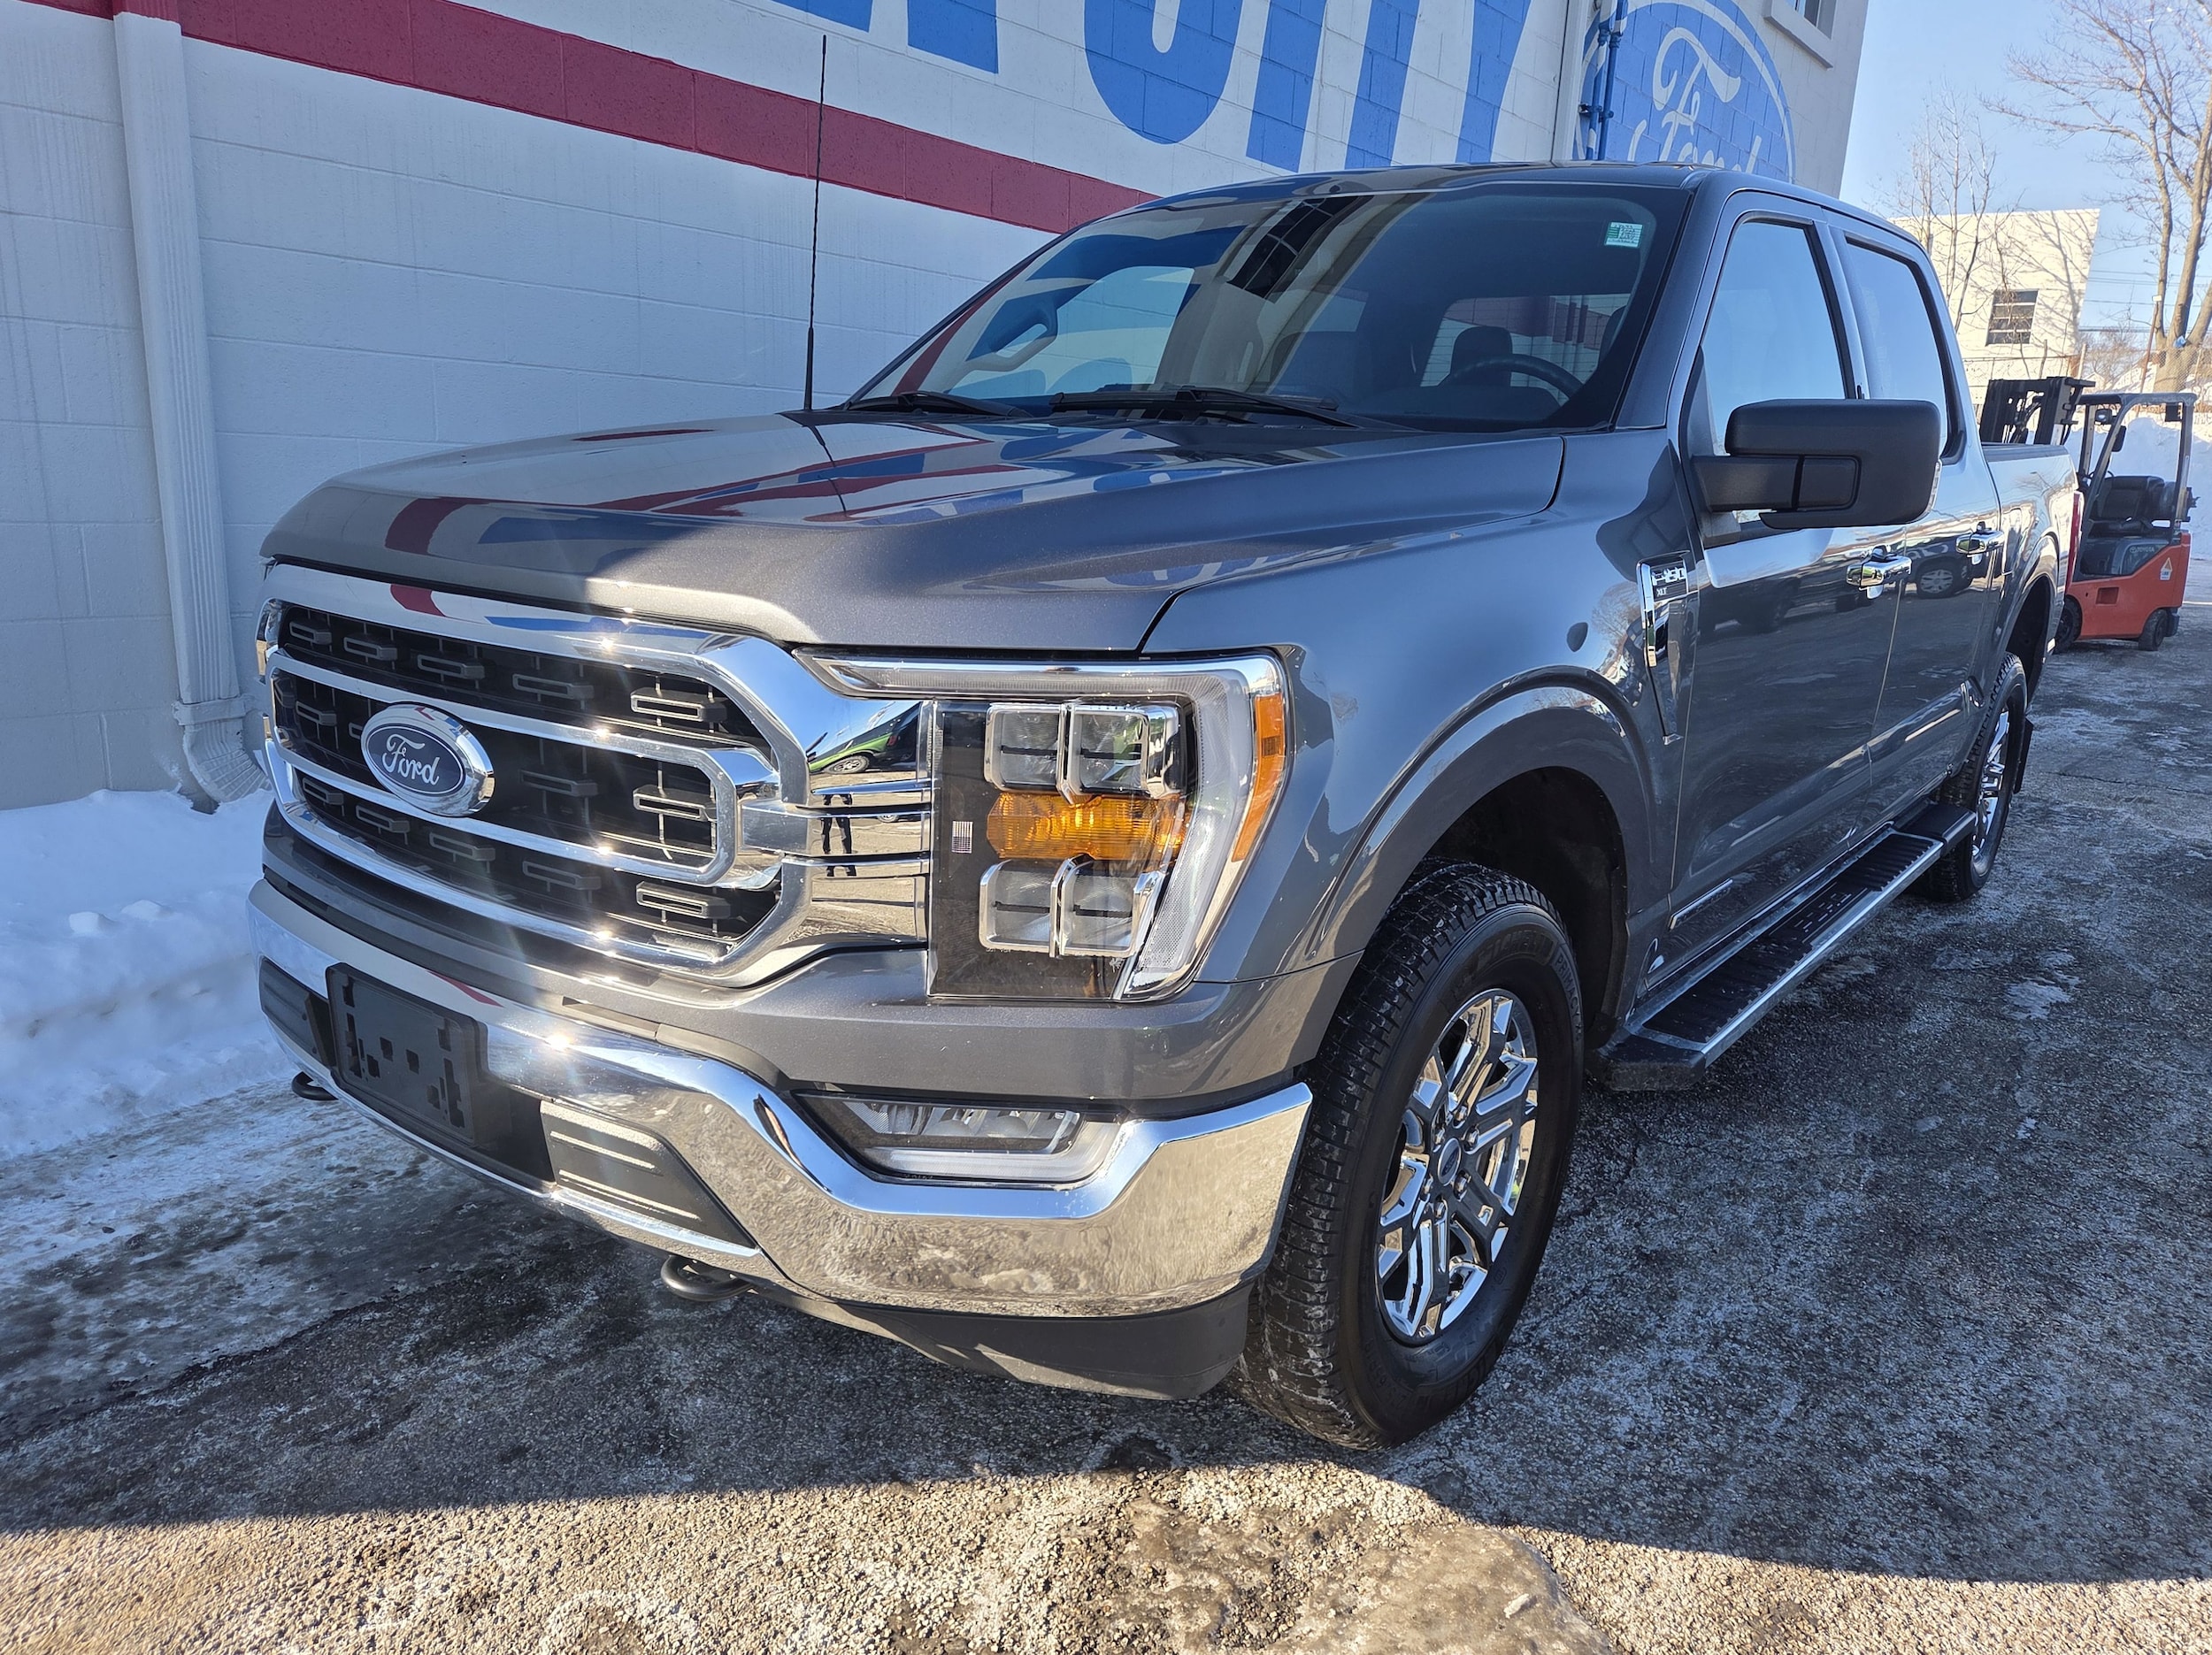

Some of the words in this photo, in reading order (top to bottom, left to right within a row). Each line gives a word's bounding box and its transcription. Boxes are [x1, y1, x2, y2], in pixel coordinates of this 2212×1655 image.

[1656, 586, 1667, 597] XLT
[382, 733, 441, 785] Ford
[1555, 955, 1581, 1018] PRIMACY
